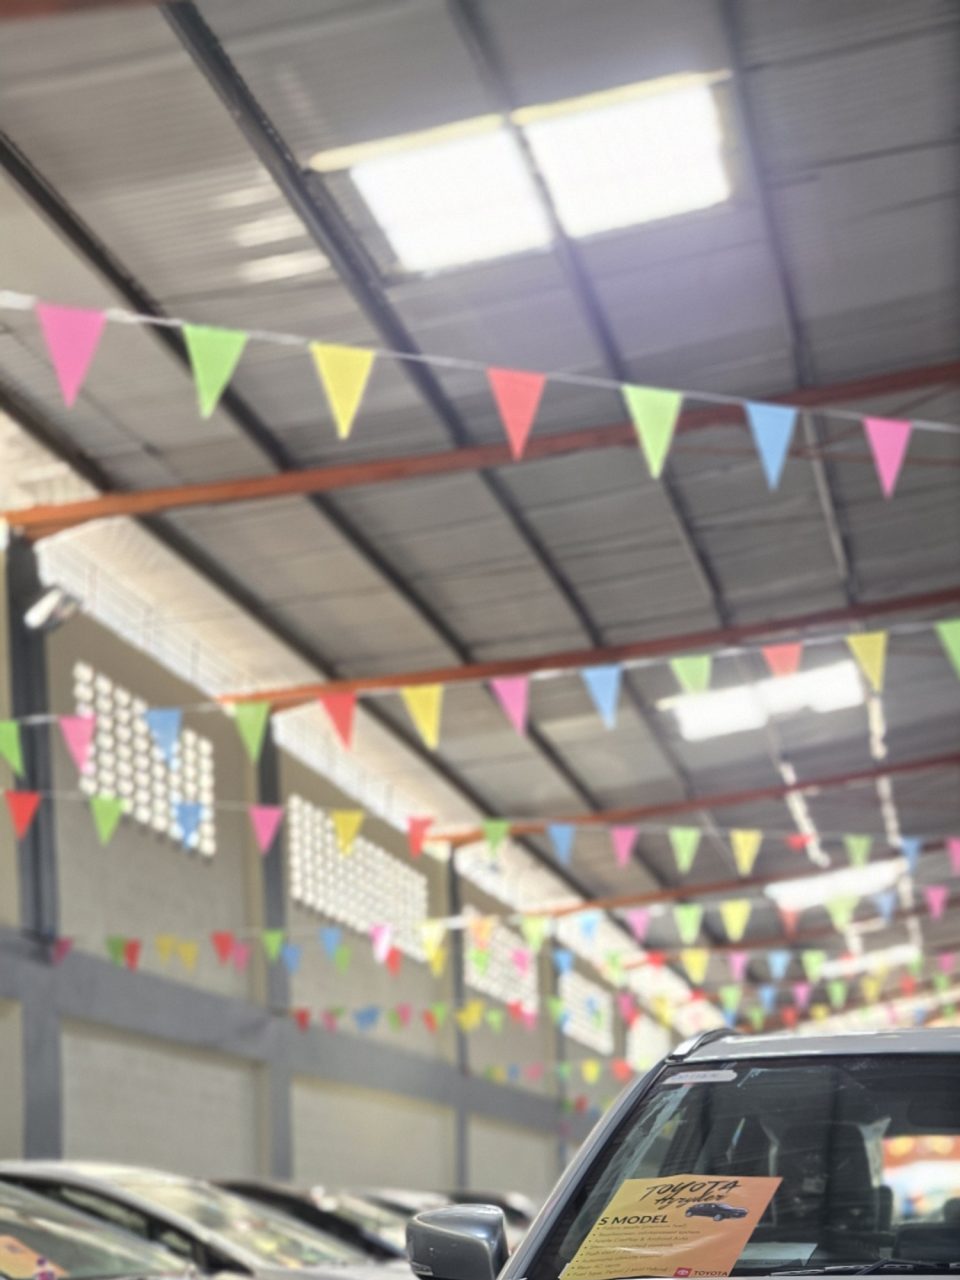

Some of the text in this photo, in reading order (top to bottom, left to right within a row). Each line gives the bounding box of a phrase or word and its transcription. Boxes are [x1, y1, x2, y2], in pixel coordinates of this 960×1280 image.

[639, 1180, 741, 1200] TOYOTA
[598, 1215, 669, 1225] S MODEL
